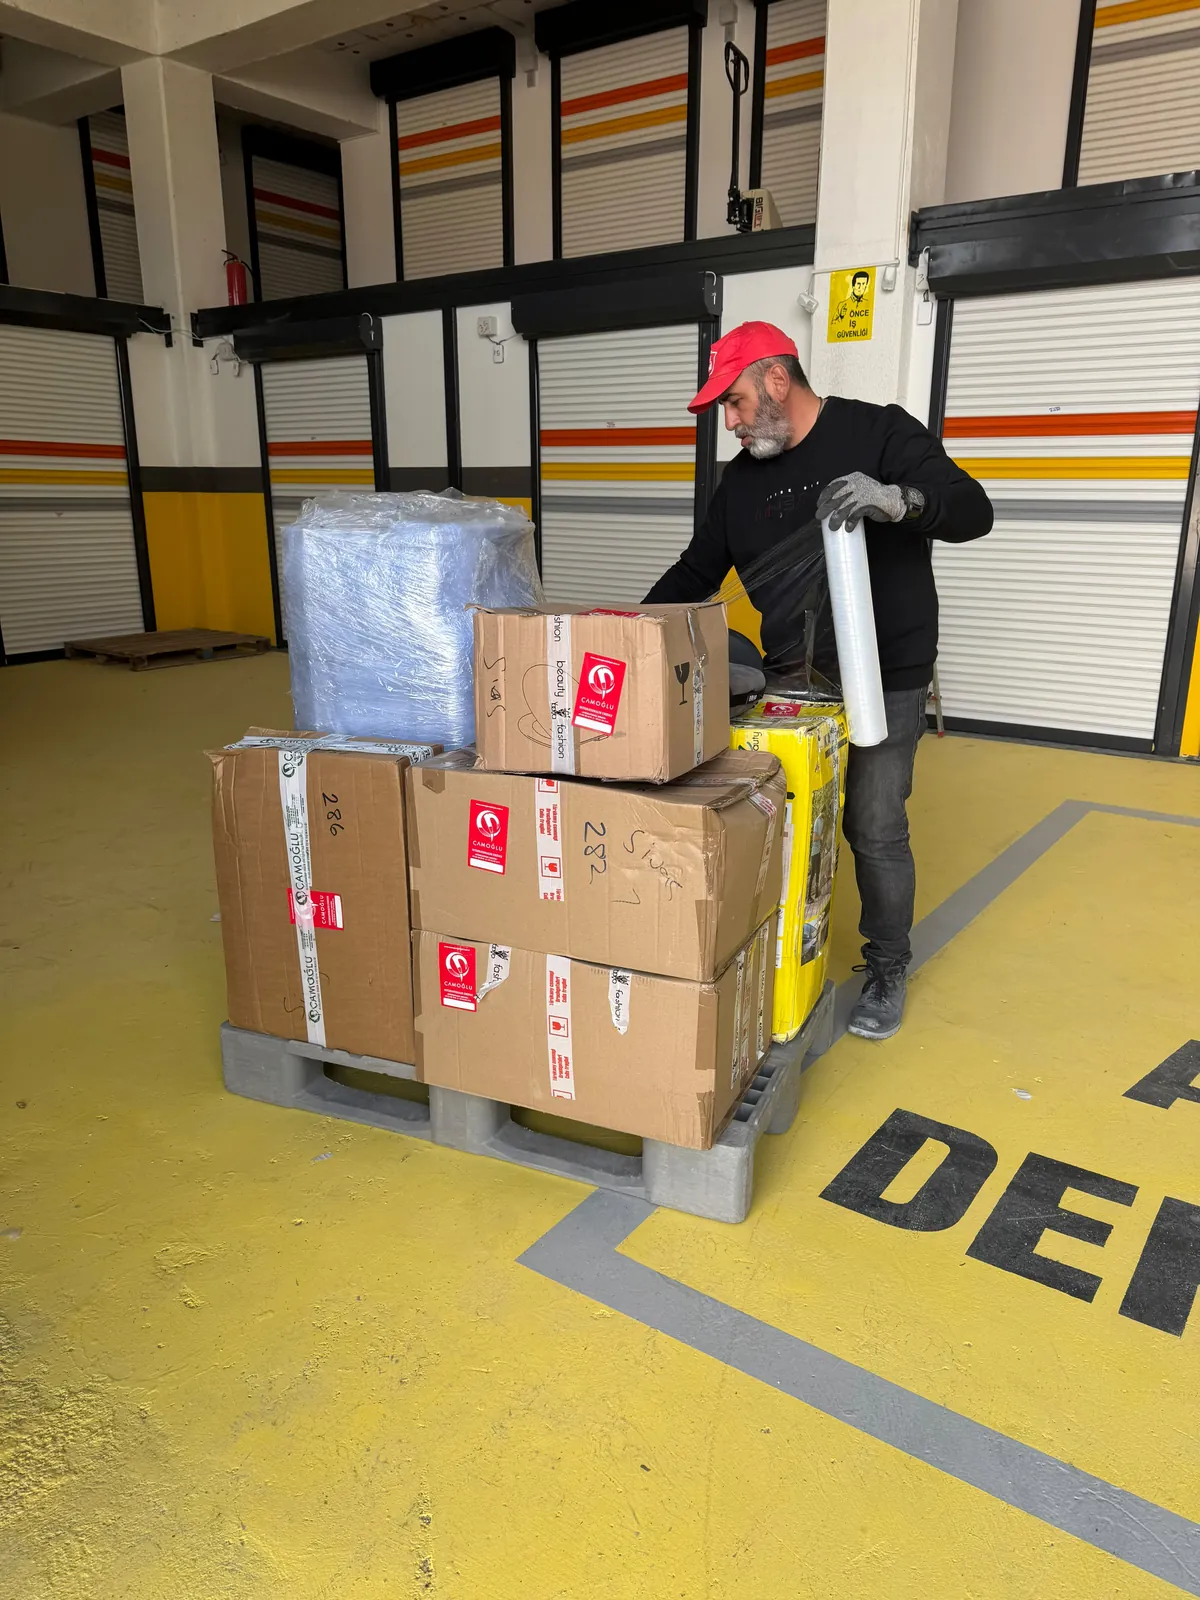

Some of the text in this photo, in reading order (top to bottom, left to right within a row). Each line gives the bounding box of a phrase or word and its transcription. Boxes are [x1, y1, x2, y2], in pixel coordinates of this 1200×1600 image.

[849, 308, 870, 318] ÖNCE
[849, 319, 857, 328] İŞ
[836, 328, 868, 339] GÜVENLİĞİ
[554, 660, 566, 698] beauty
[556, 723, 567, 759] fashion
[322, 791, 345, 837] 286
[584, 821, 606, 885] 282
